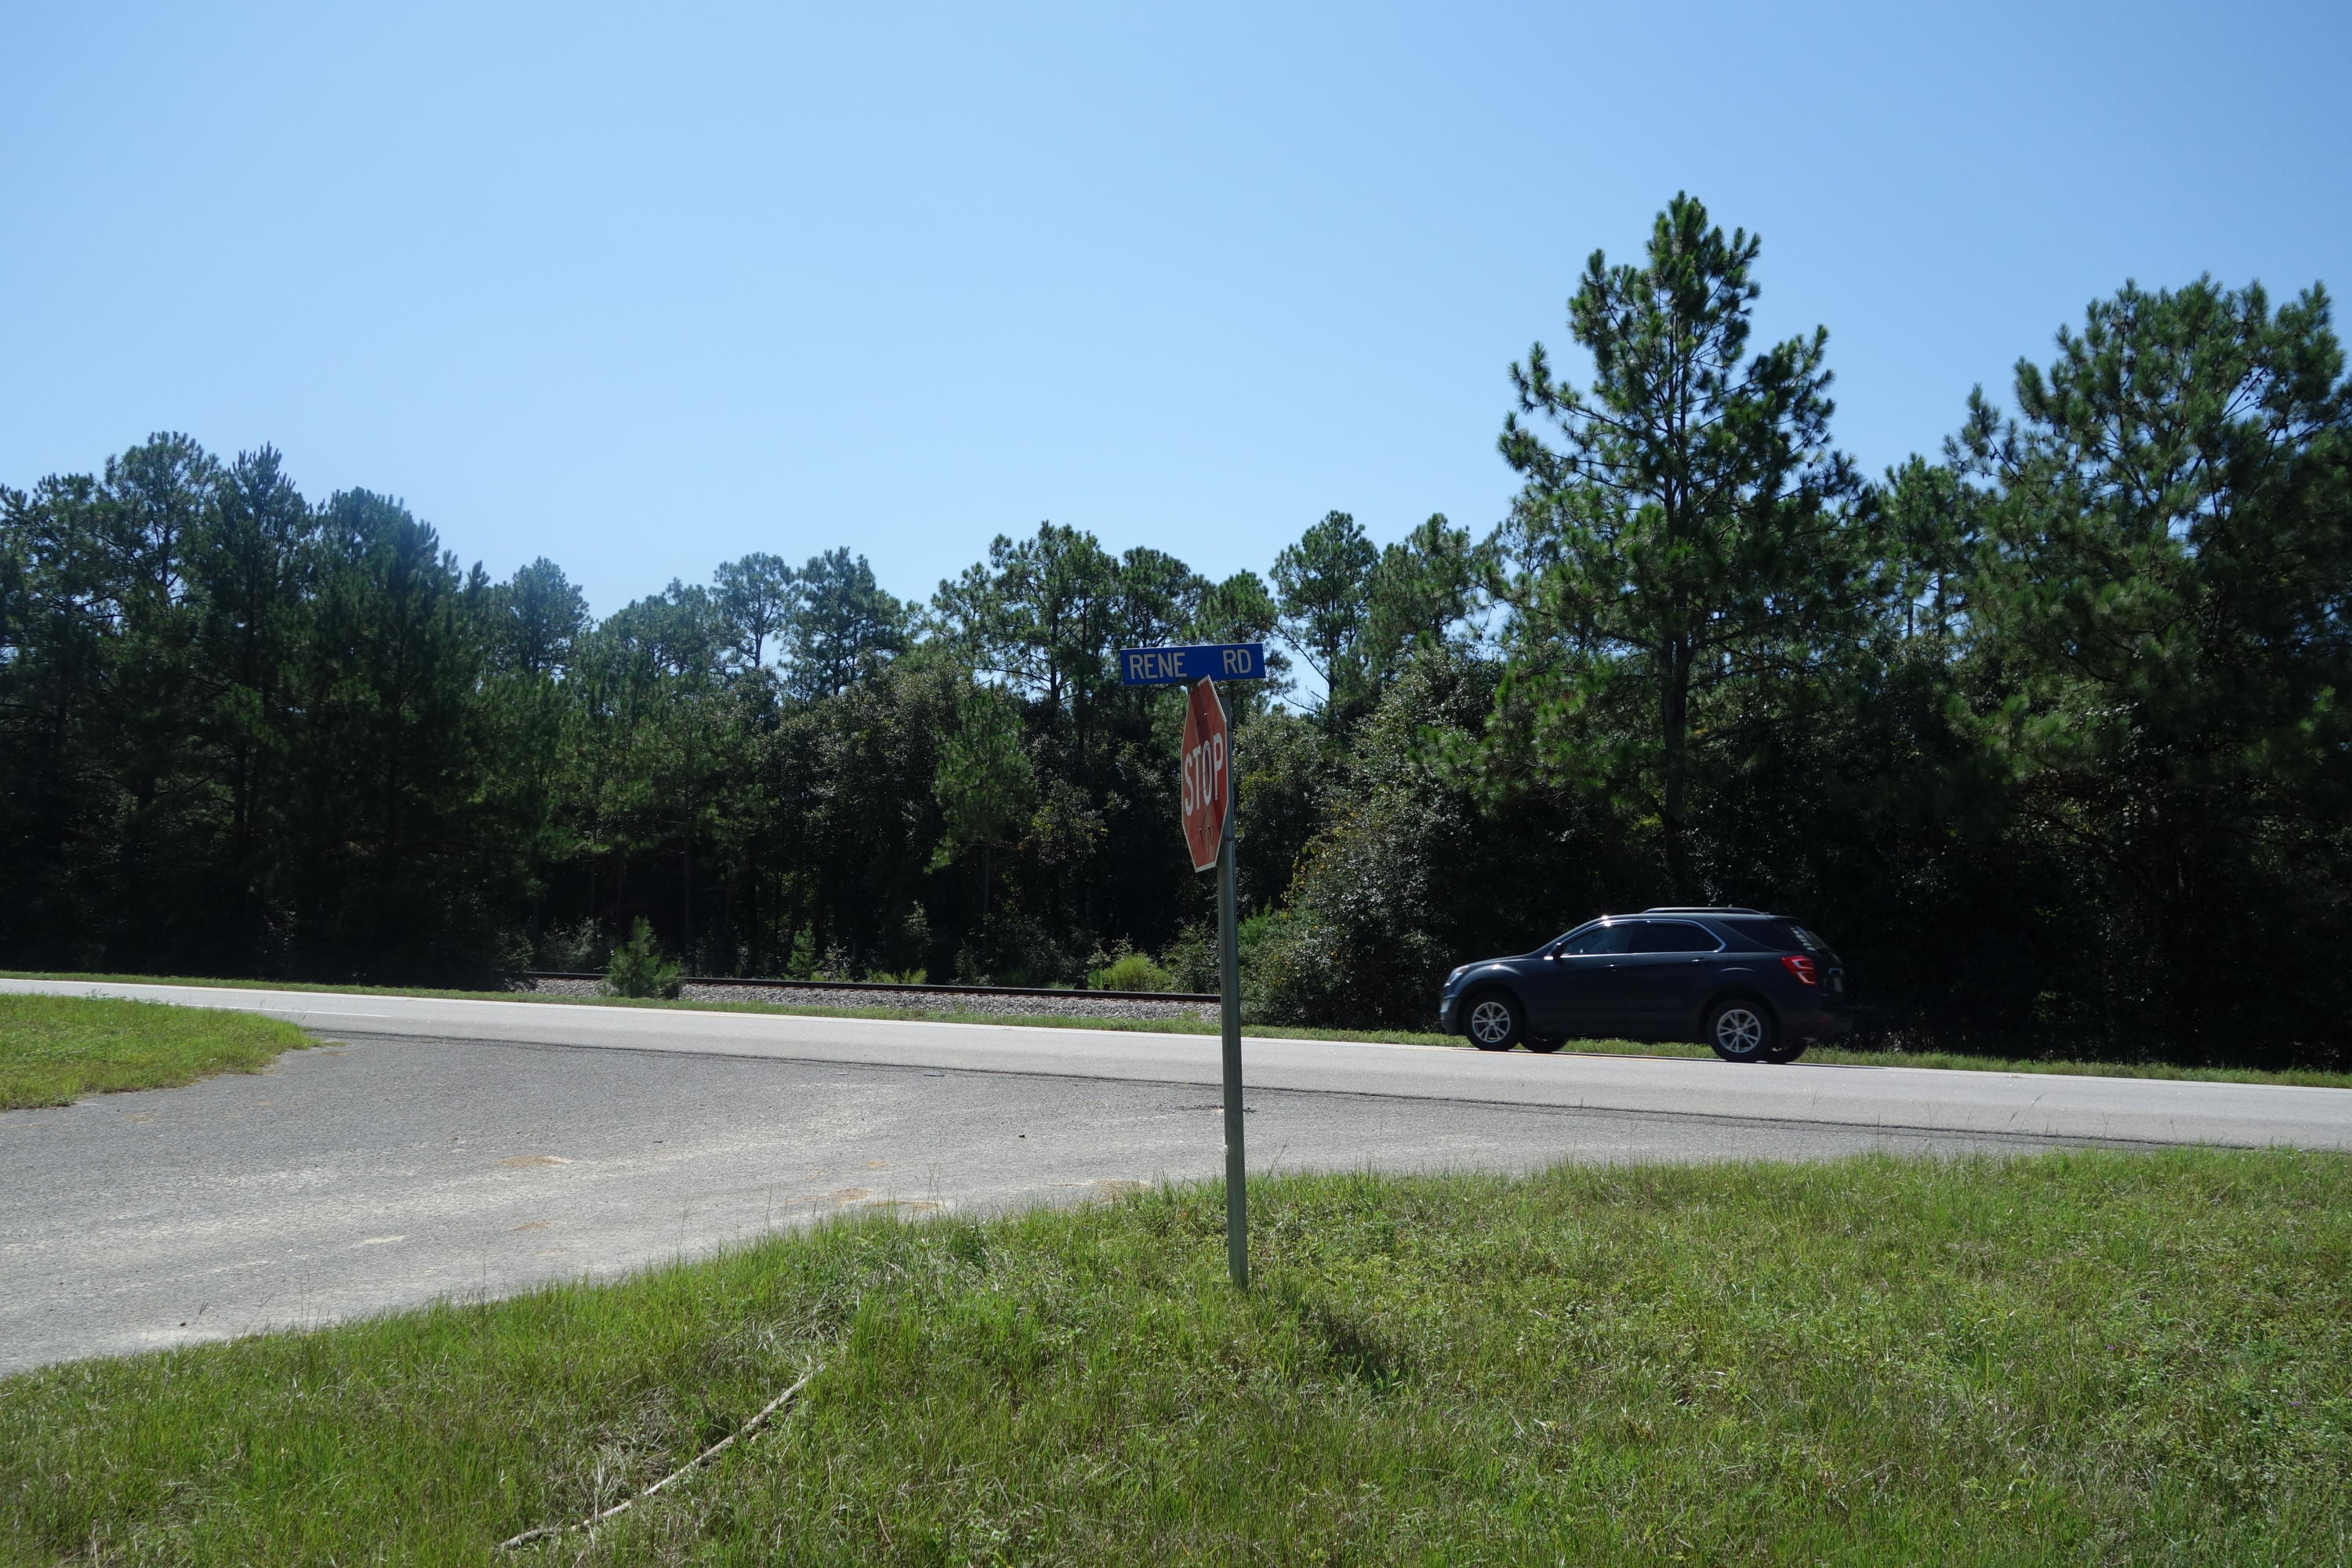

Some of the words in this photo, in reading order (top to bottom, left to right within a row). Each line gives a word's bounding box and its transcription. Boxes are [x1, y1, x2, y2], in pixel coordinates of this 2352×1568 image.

[1129, 652, 1187, 679] RENE
[1222, 649, 1251, 674] RD
[1185, 732, 1223, 815] STOP
